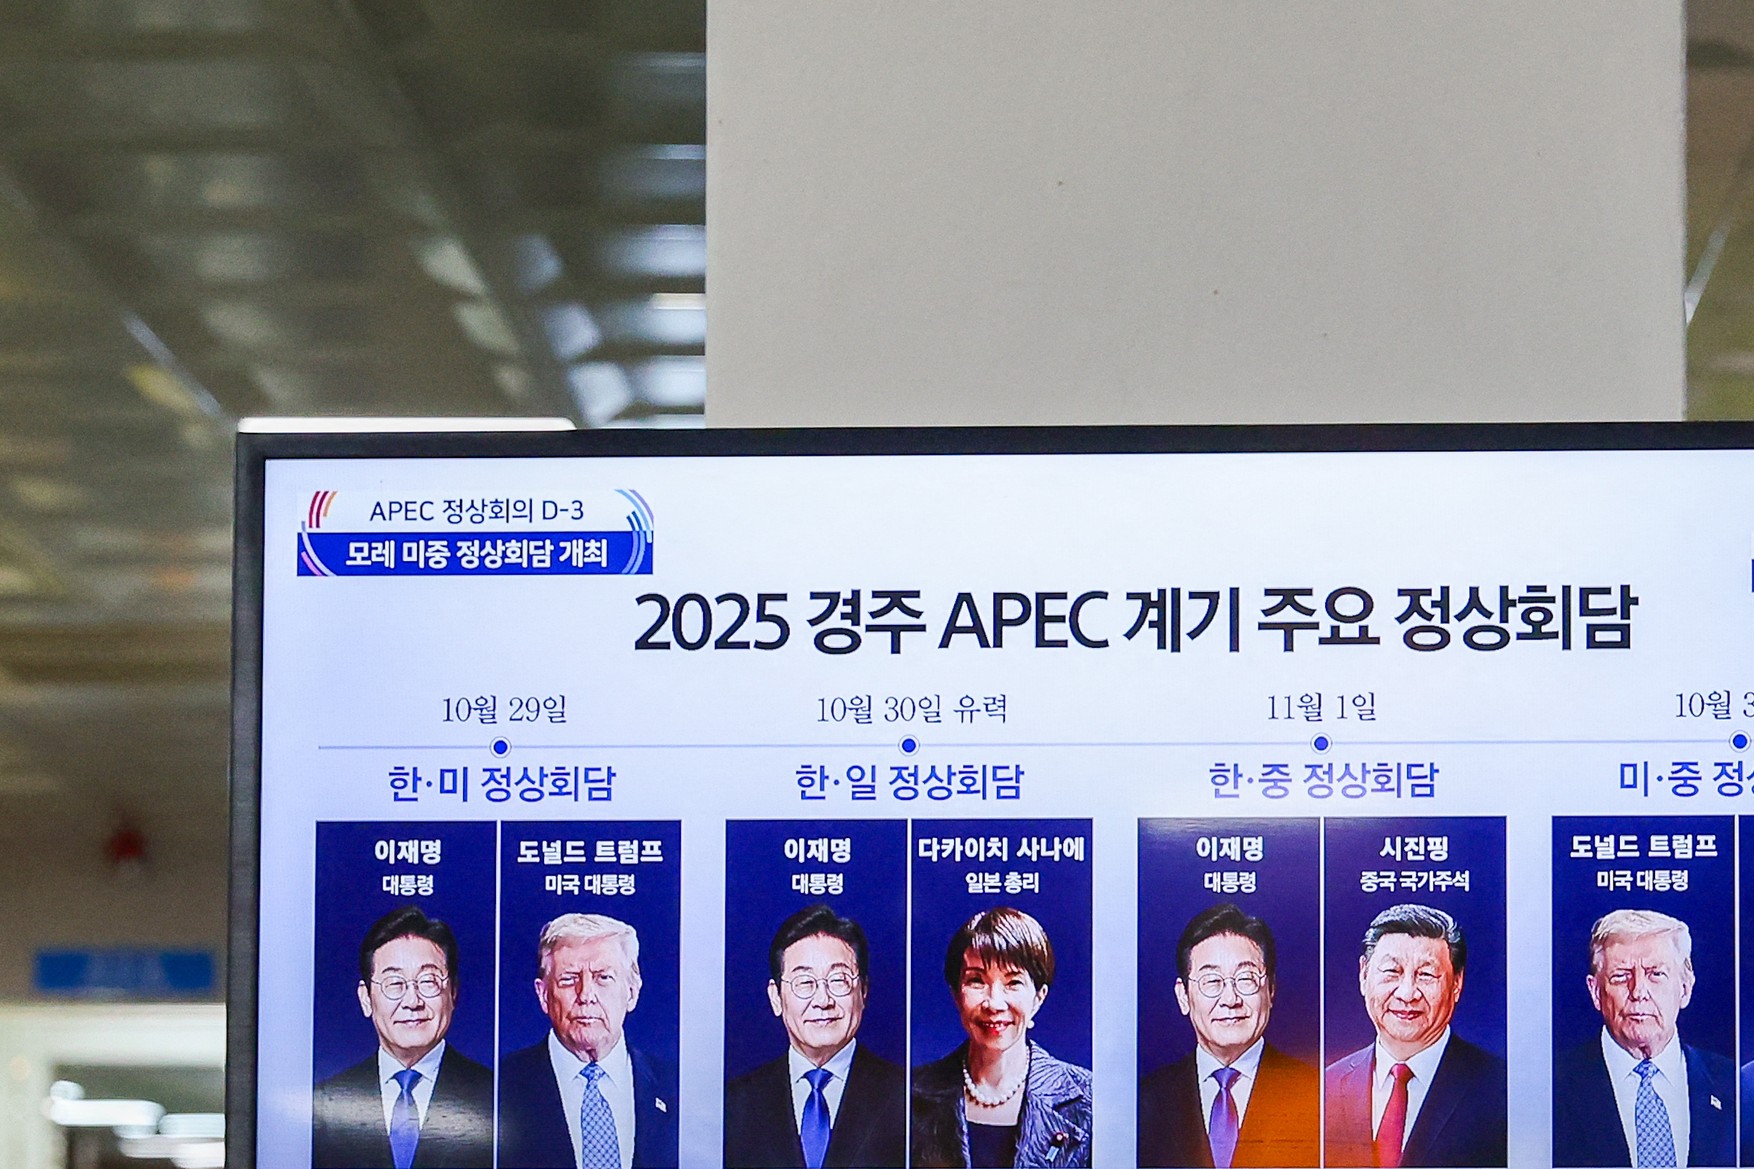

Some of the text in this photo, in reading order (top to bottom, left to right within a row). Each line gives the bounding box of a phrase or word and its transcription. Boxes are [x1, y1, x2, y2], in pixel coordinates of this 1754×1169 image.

[369, 498, 584, 525] APEC 정상회의 D-3
[345, 538, 608, 569] 모레 미중 정상회담 개최
[634, 584, 1639, 655] 2025 경주 APEC 계기 주요 정상회담
[443, 694, 567, 725] 10월 29일
[817, 693, 1006, 725] 10월 30일 유력
[1268, 692, 1376, 722] 11월 1일
[1676, 689, 1732, 720] 10월
[481, 765, 617, 803] 정상회담
[888, 764, 1025, 801] 정상회담
[1304, 762, 1440, 799] 정상회담
[374, 839, 442, 865] 이재명
[517, 839, 664, 865] 도널드 트럼프
[784, 837, 851, 864] 이재명
[918, 836, 1085, 862] 다카이치 사나에
[1196, 836, 1264, 862] 이재명
[1379, 835, 1448, 862] 시진핑
[1570, 834, 1718, 860] 도널드 트럼프
[382, 874, 434, 896] 대통령
[545, 873, 636, 896] 미국 대통령
[791, 872, 844, 895] 대통령
[965, 871, 1039, 894] 일본 총리
[1203, 871, 1257, 894] 대통령
[1359, 870, 1470, 893] 중국 국가주석
[1597, 869, 1689, 892] 미국 대통령
